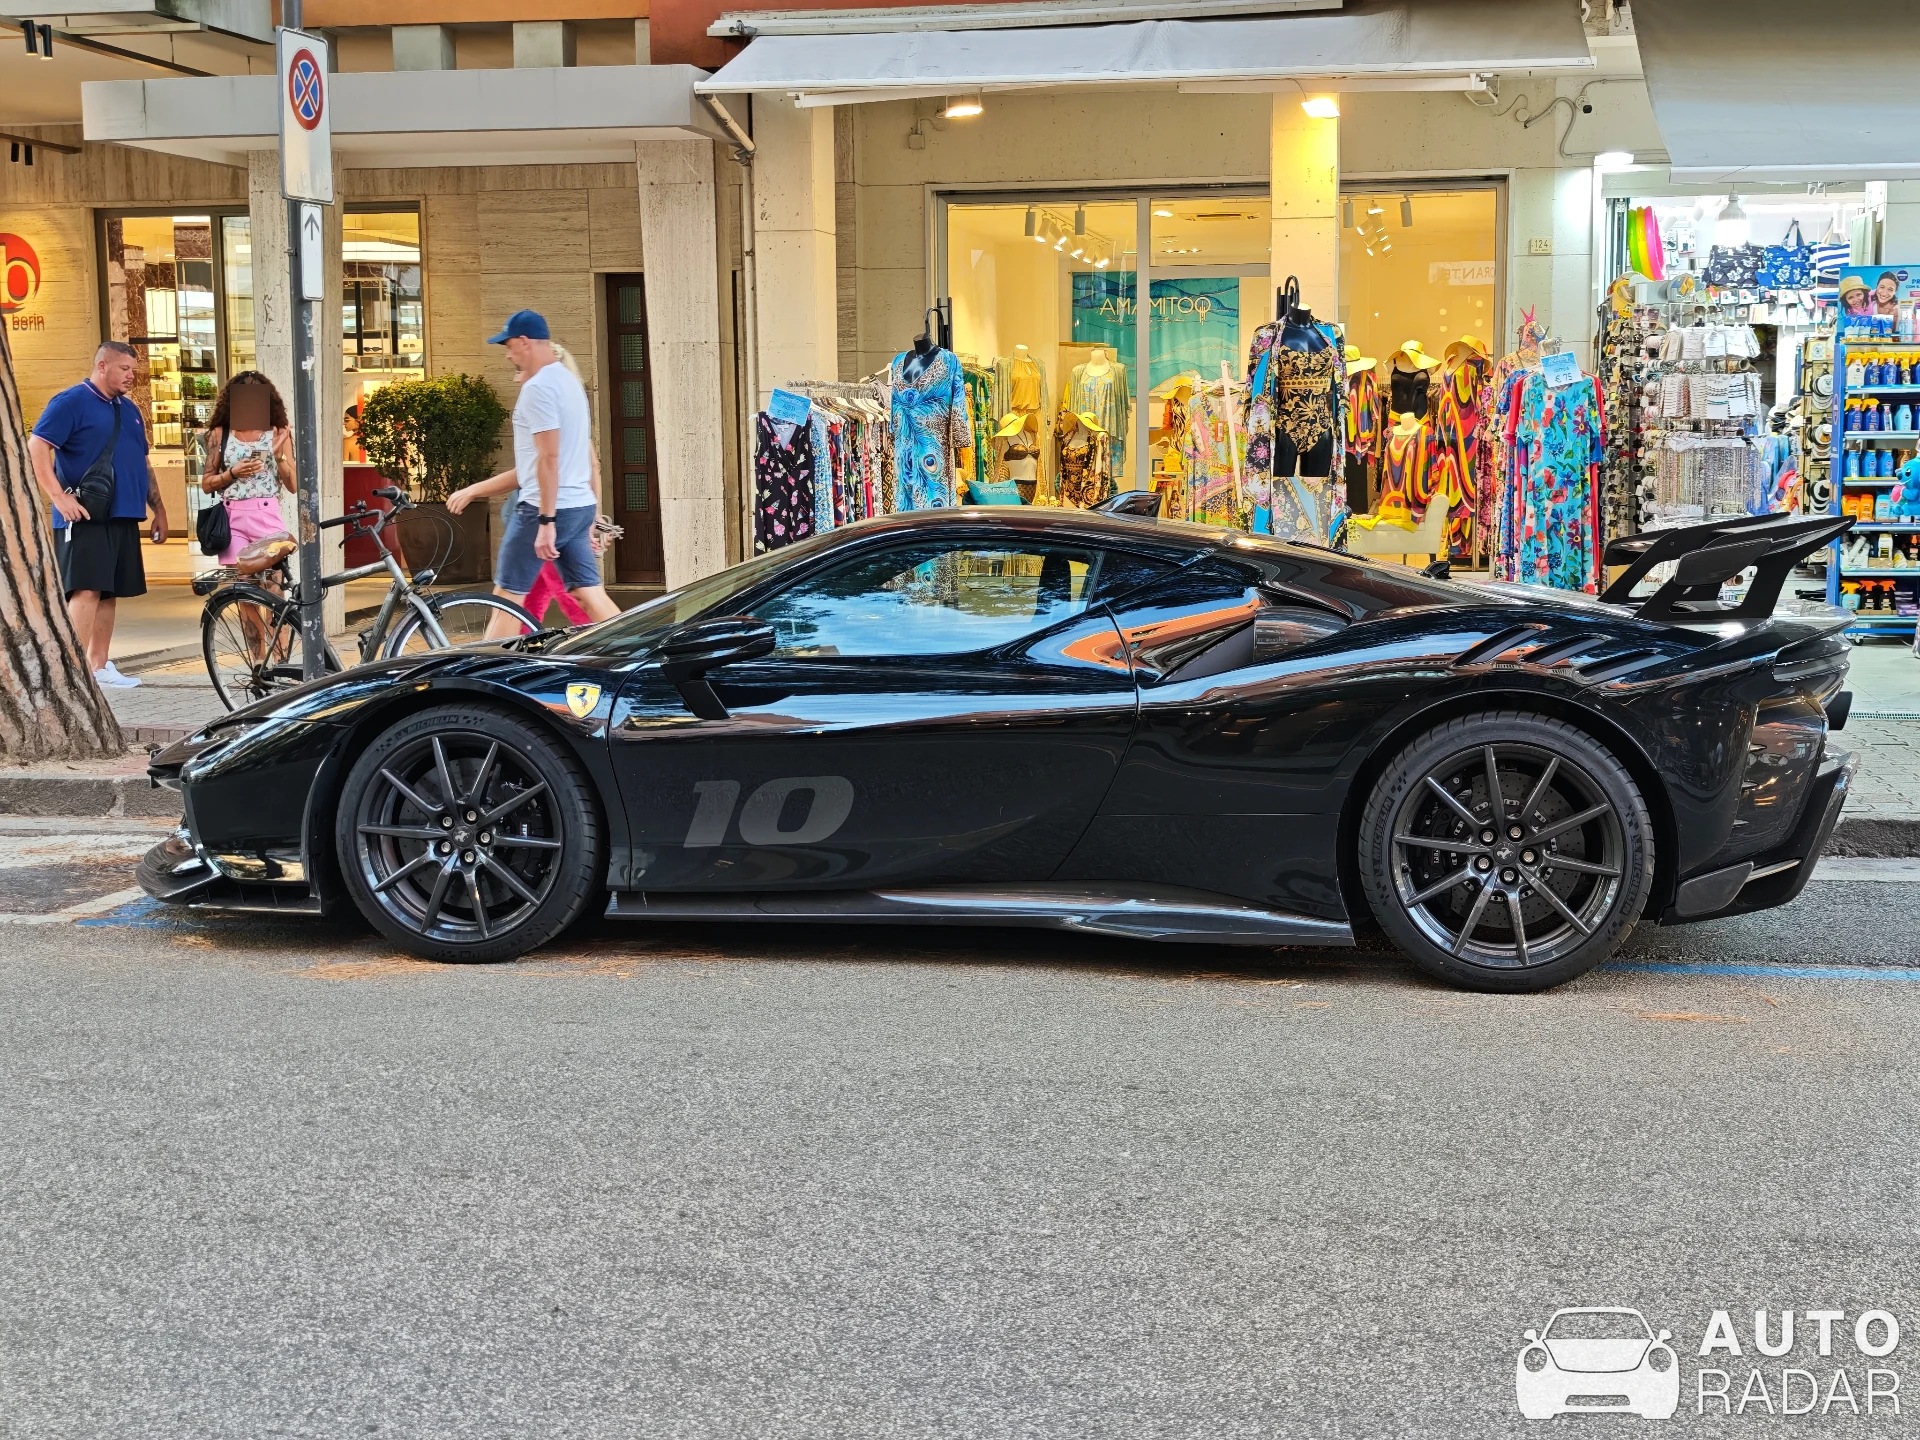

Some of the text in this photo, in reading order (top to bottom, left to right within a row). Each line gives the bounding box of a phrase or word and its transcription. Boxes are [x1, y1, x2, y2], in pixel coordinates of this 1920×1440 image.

[1534, 239, 1549, 249] 124
[408, 714, 459, 734] MICHELIN
[683, 775, 855, 848] 10
[1372, 798, 1393, 860] MICHELIN
[1621, 851, 1642, 916] MICHELIN
